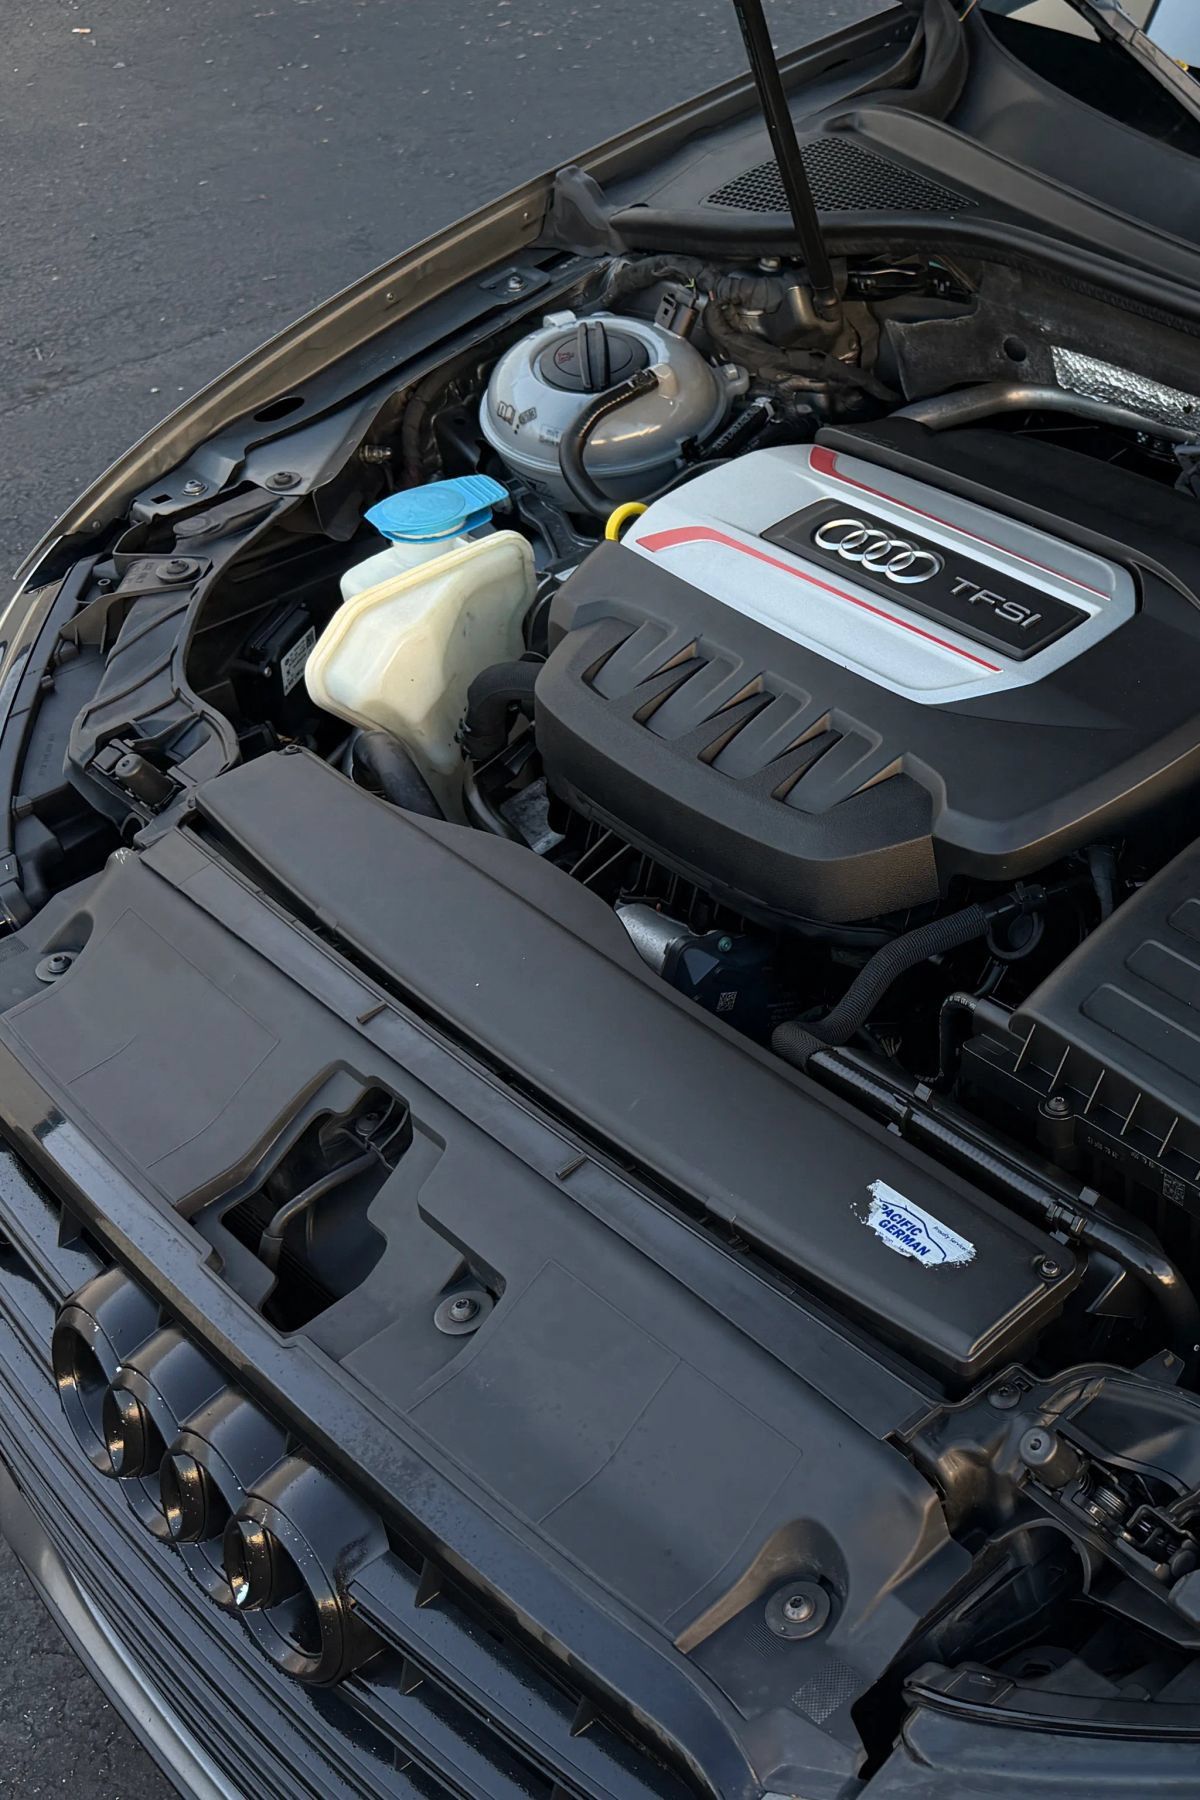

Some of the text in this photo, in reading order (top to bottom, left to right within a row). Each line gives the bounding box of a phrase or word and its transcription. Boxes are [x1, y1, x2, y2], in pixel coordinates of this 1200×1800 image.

[950, 576, 1042, 629] TFSI
[878, 1219, 931, 1256] GERMAN
[881, 1204, 923, 1236] PACIFIC
